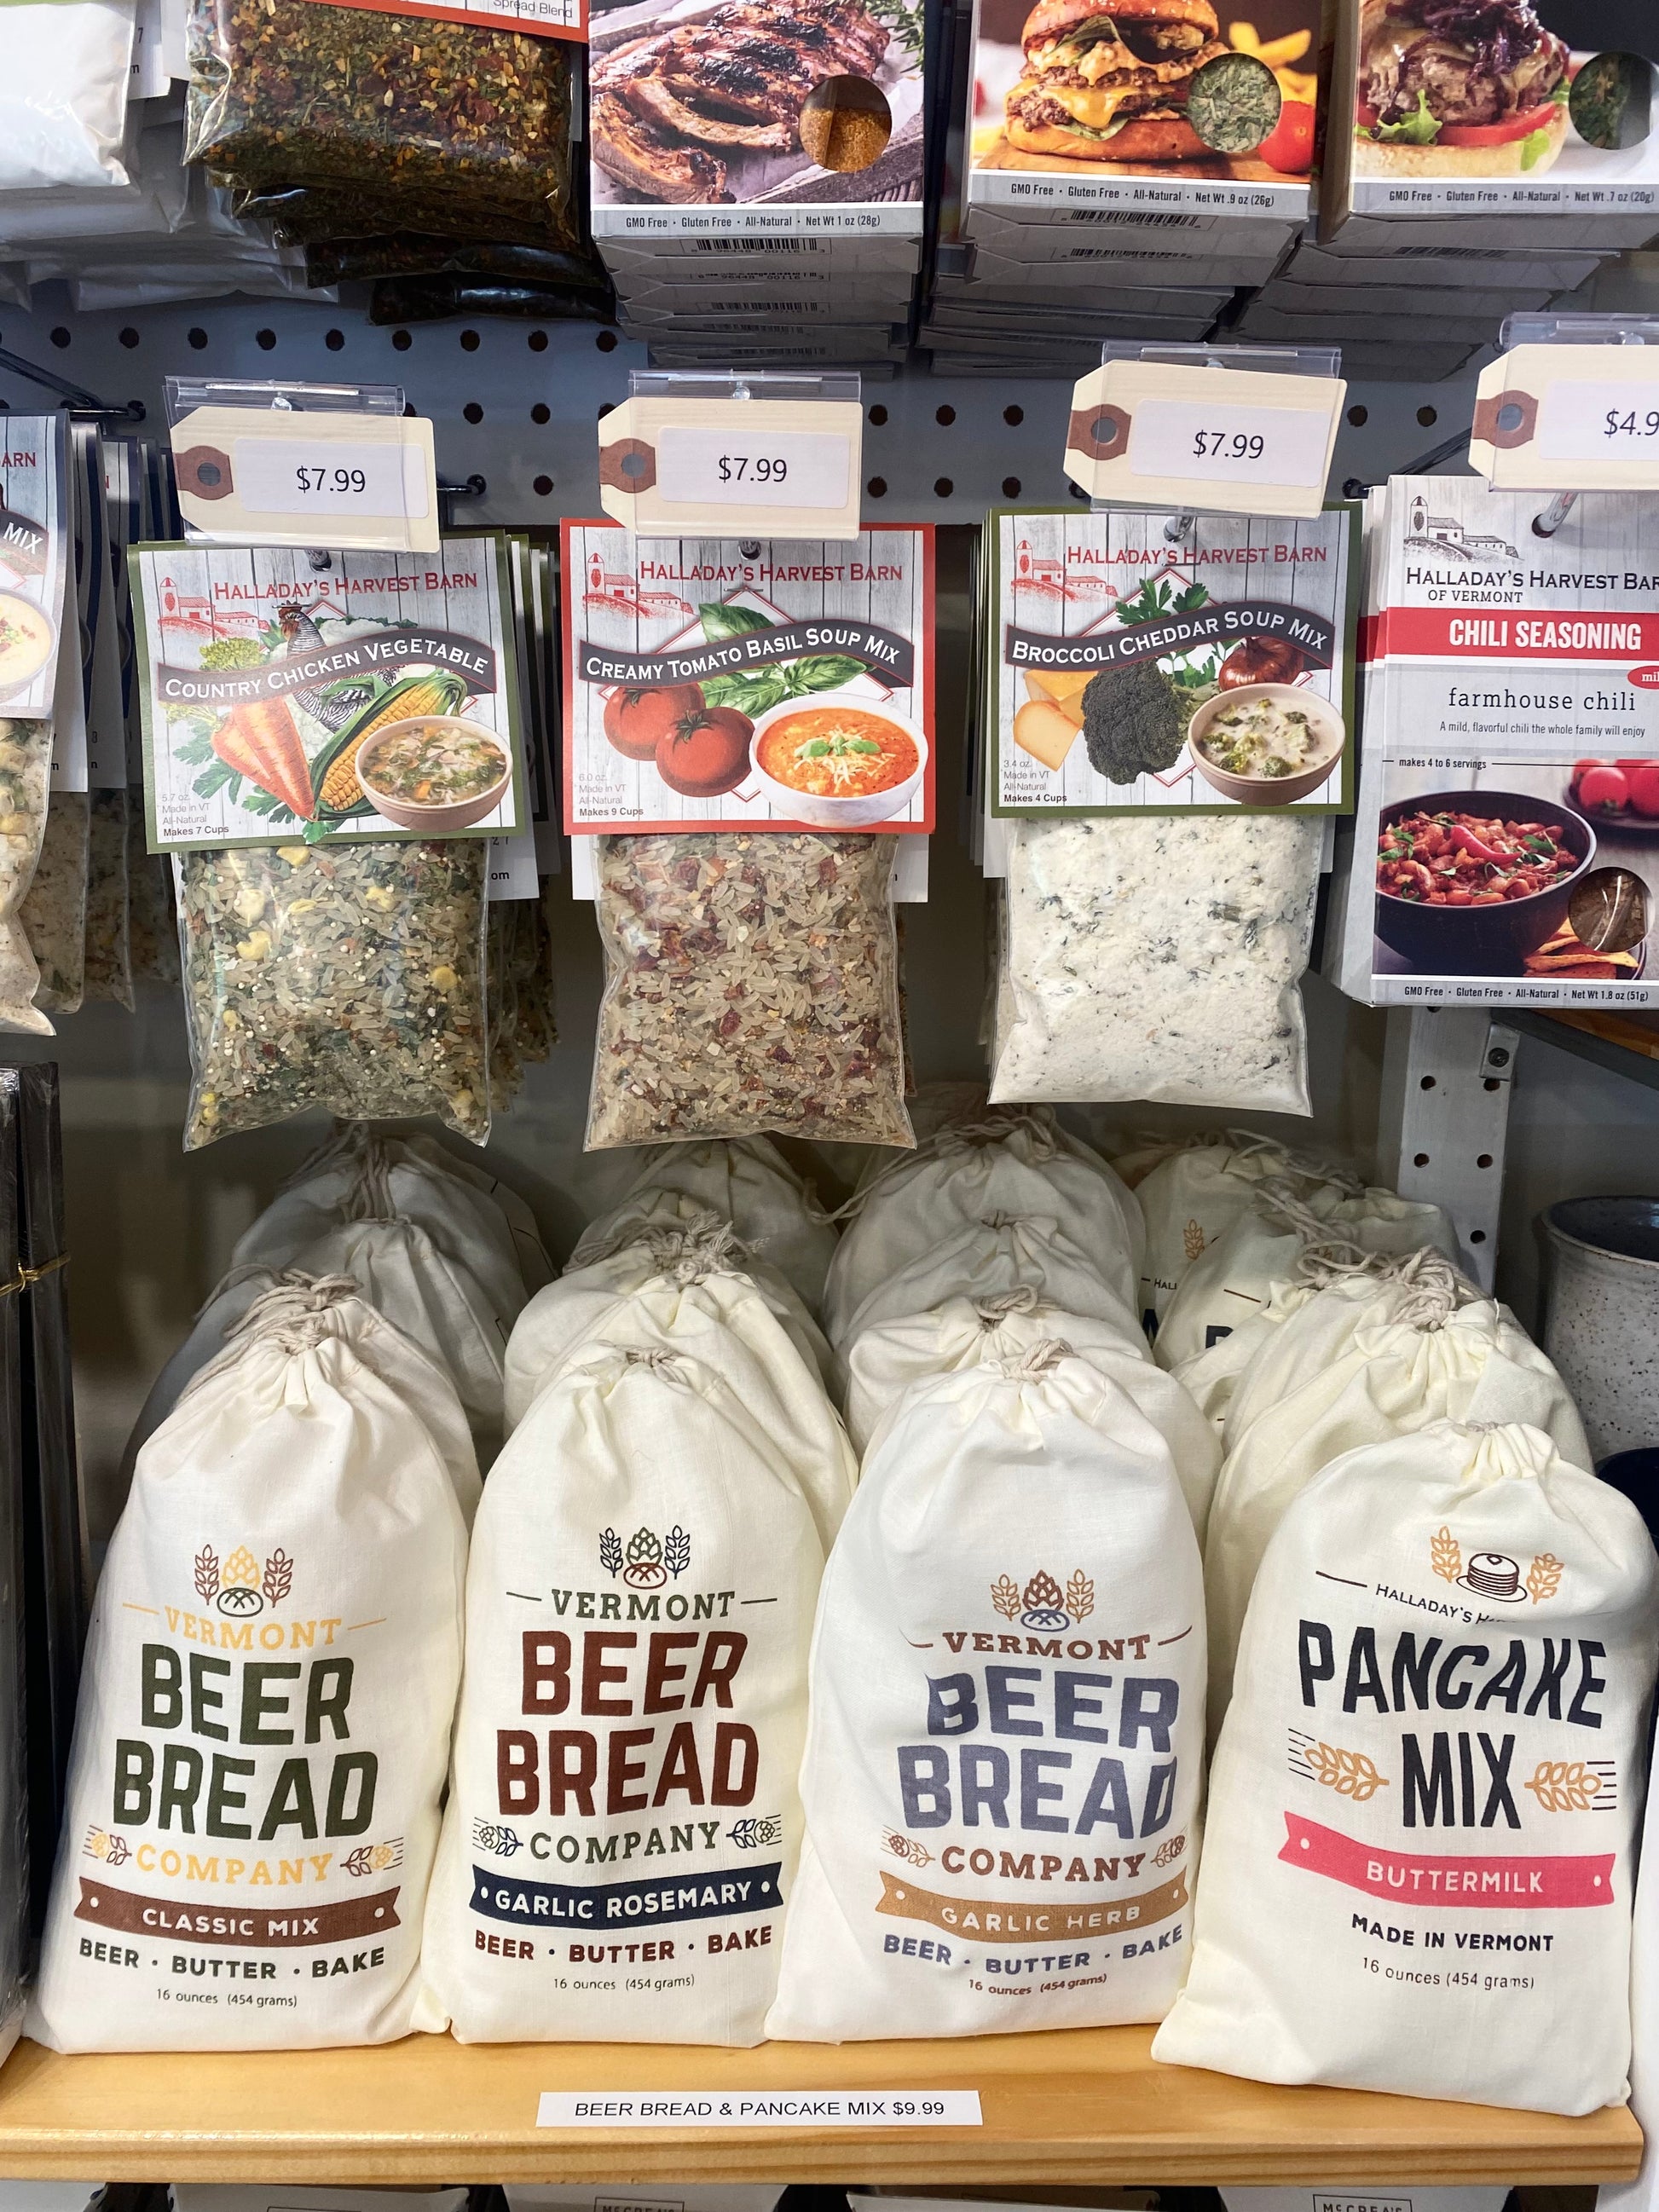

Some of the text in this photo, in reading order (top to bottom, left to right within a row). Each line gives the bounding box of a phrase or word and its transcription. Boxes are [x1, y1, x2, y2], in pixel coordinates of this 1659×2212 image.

[539, 3, 573, 18] Blend
[1011, 183, 1031, 194] GMO
[1032, 185, 1054, 195] Free
[1068, 186, 1097, 198] Gluten
[1100, 188, 1119, 199] Free
[1133, 188, 1182, 201] All-Natural
[1195, 192, 1211, 203] Net
[1212, 193, 1224, 203] Wt
[1227, 193, 1236, 204] .9
[1251, 194, 1275, 207] (26g)
[626, 217, 645, 228] GMO
[648, 217, 668, 228] Free
[681, 217, 708, 227] Gluten
[712, 217, 731, 227] Free
[745, 216, 792, 227] All-Natural
[806, 216, 820, 226] Net
[822, 216, 835, 226] Wt
[837, 216, 841, 226] 1
[857, 215, 881, 227] (28g)
[1193, 430, 1264, 459] $7.99
[297, 465, 366, 494] $7.99
[719, 454, 788, 483] $7.99
[3, 522, 43, 554] MIX
[1067, 545, 1327, 564] HALLADAY'S HARVEST BARN
[640, 560, 902, 581] HALLADAY'S HARVEST BARN
[1406, 567, 1523, 587] HALLADAY'S
[1529, 570, 1619, 589] HARVEST
[214, 572, 478, 601] HALLADAY'S HARVEST BARN
[1428, 590, 1523, 603] OF VERMONT
[1012, 609, 1328, 663] BROCCOLI CHEDDAR SOUP MIX
[1449, 619, 1641, 650] CHILI SEASONING
[165, 638, 488, 700] COUNTRY CHICKEN VEGETABLE
[586, 627, 900, 680] CREAMY TOMATO BASIL SOUP MIX
[1448, 687, 1636, 711] farmhouse chili
[1440, 722, 1645, 737] A mild, flavorful chili the whole family will enjoy
[1399, 758, 1487, 771] makes 4 to 6 servings
[620, 807, 644, 817] Cups
[1003, 794, 1032, 802] Makes
[1043, 794, 1067, 803] Cups
[163, 828, 194, 836] Makes
[205, 826, 229, 835] Cups
[1404, 987, 1422, 996] GMO
[1425, 986, 1443, 996] Free
[1456, 987, 1483, 997] Gluten
[1484, 988, 1503, 997] Free
[1516, 989, 1559, 998] All-Natural
[1571, 990, 1586, 999] Net
[1587, 990, 1598, 999] Wt
[1601, 990, 1613, 1000] 1.8
[1627, 990, 1649, 1002] (51g)
[552, 1588, 736, 1621] VERMONT
[1376, 1584, 1472, 1623] HALLADAY'S
[164, 1605, 341, 1650] VERMONT
[942, 1632, 1151, 1661] VERMONT
[522, 1631, 748, 1716] BEER
[1298, 1619, 1607, 1730] PANCAKE
[141, 1643, 354, 1746] BEER
[924, 1665, 1179, 1753] BEER
[496, 1721, 760, 1816] BREAD
[1402, 1731, 1522, 1829] MIX
[113, 1739, 379, 1840] BREAD
[897, 1744, 1177, 1839] BREAD
[529, 1821, 720, 1864] COMPANY
[136, 1844, 334, 1886] COMPANY
[940, 1846, 1147, 1882] COMPANY
[1366, 1861, 1544, 1894] BUTTERMILK
[494, 1880, 752, 1920] GARLIC ROSEMARY
[142, 1908, 319, 1937] CLASSIC MIX
[941, 1905, 1141, 1932] GARLIC HERB
[1351, 1913, 1554, 1952] MADE IN VERMONT
[79, 1938, 384, 1979] BEER BUTTER BAKE
[475, 1925, 772, 1964] BEER BUTTER BAKE
[883, 1924, 1183, 1975] BEER BUTTER BAKE
[553, 1973, 695, 1992] 16 ounces (454 grams)
[968, 1973, 1107, 1995] 16 ounces (454 grams)
[1362, 1956, 1535, 1990] 16 ounces (454 grams)
[156, 1988, 298, 2008] 16 ounces (454 grams)
[574, 2101, 945, 2117] BEER BREAD & PANCAKE MIX $9.99
